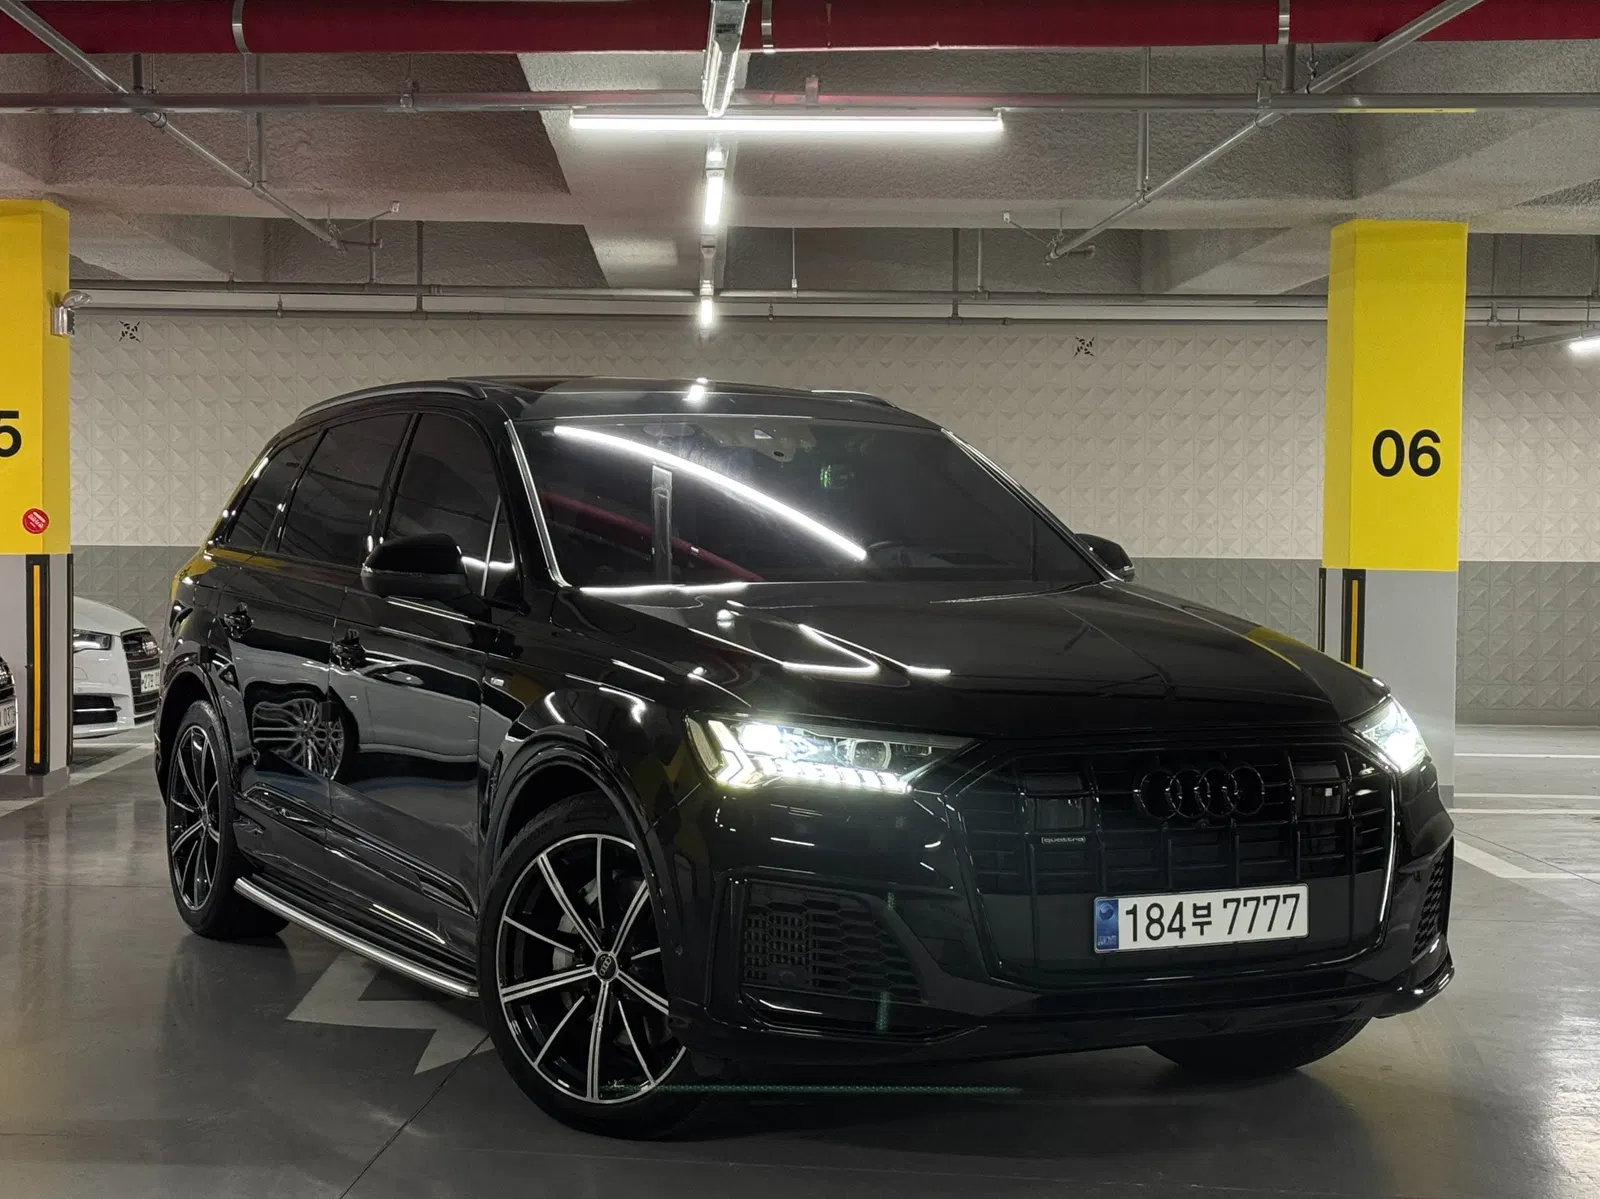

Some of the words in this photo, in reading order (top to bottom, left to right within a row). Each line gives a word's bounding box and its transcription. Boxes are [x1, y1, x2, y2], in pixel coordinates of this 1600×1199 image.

[1372, 429, 1441, 477] 06
[1125, 901, 1212, 942] 184부
[1223, 893, 1300, 935] 7777
